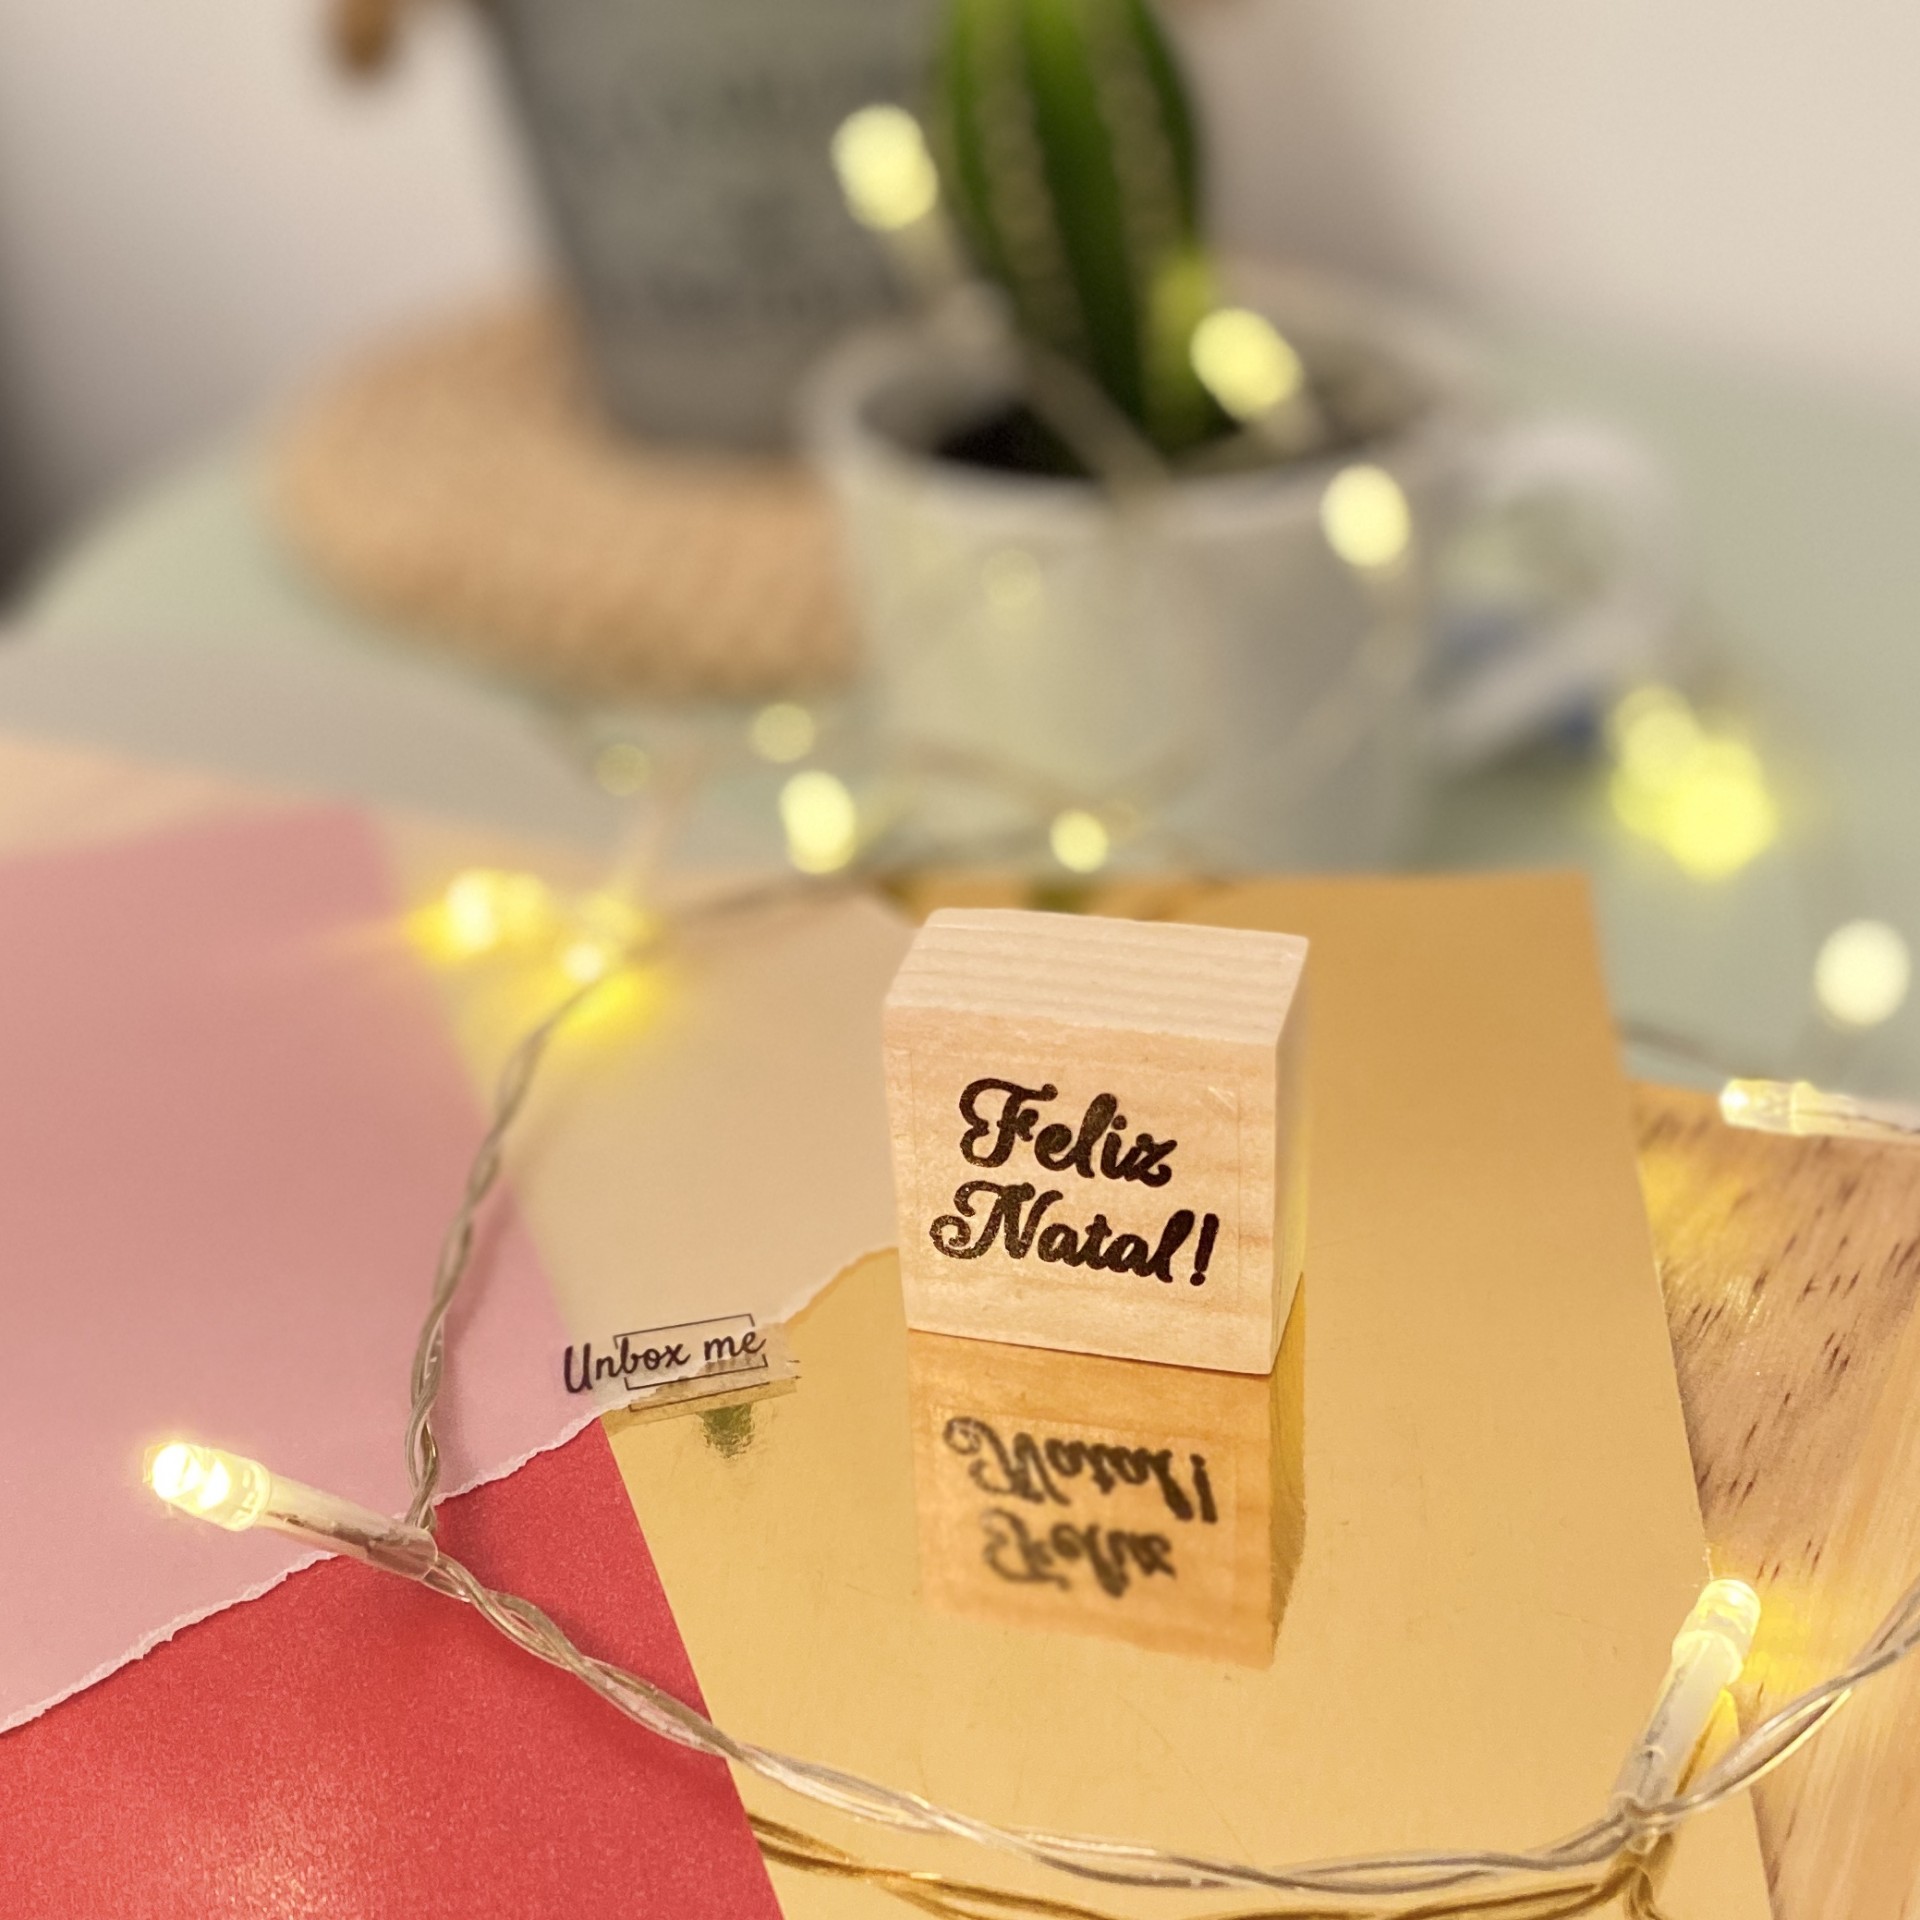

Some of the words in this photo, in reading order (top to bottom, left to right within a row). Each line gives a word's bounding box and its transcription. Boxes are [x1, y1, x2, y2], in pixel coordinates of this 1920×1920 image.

[959, 1078, 1177, 1187] Feliz
[929, 1180, 1219, 1286] Natal!
[564, 1336, 690, 1393] Unbox
[704, 1331, 767, 1361] me
